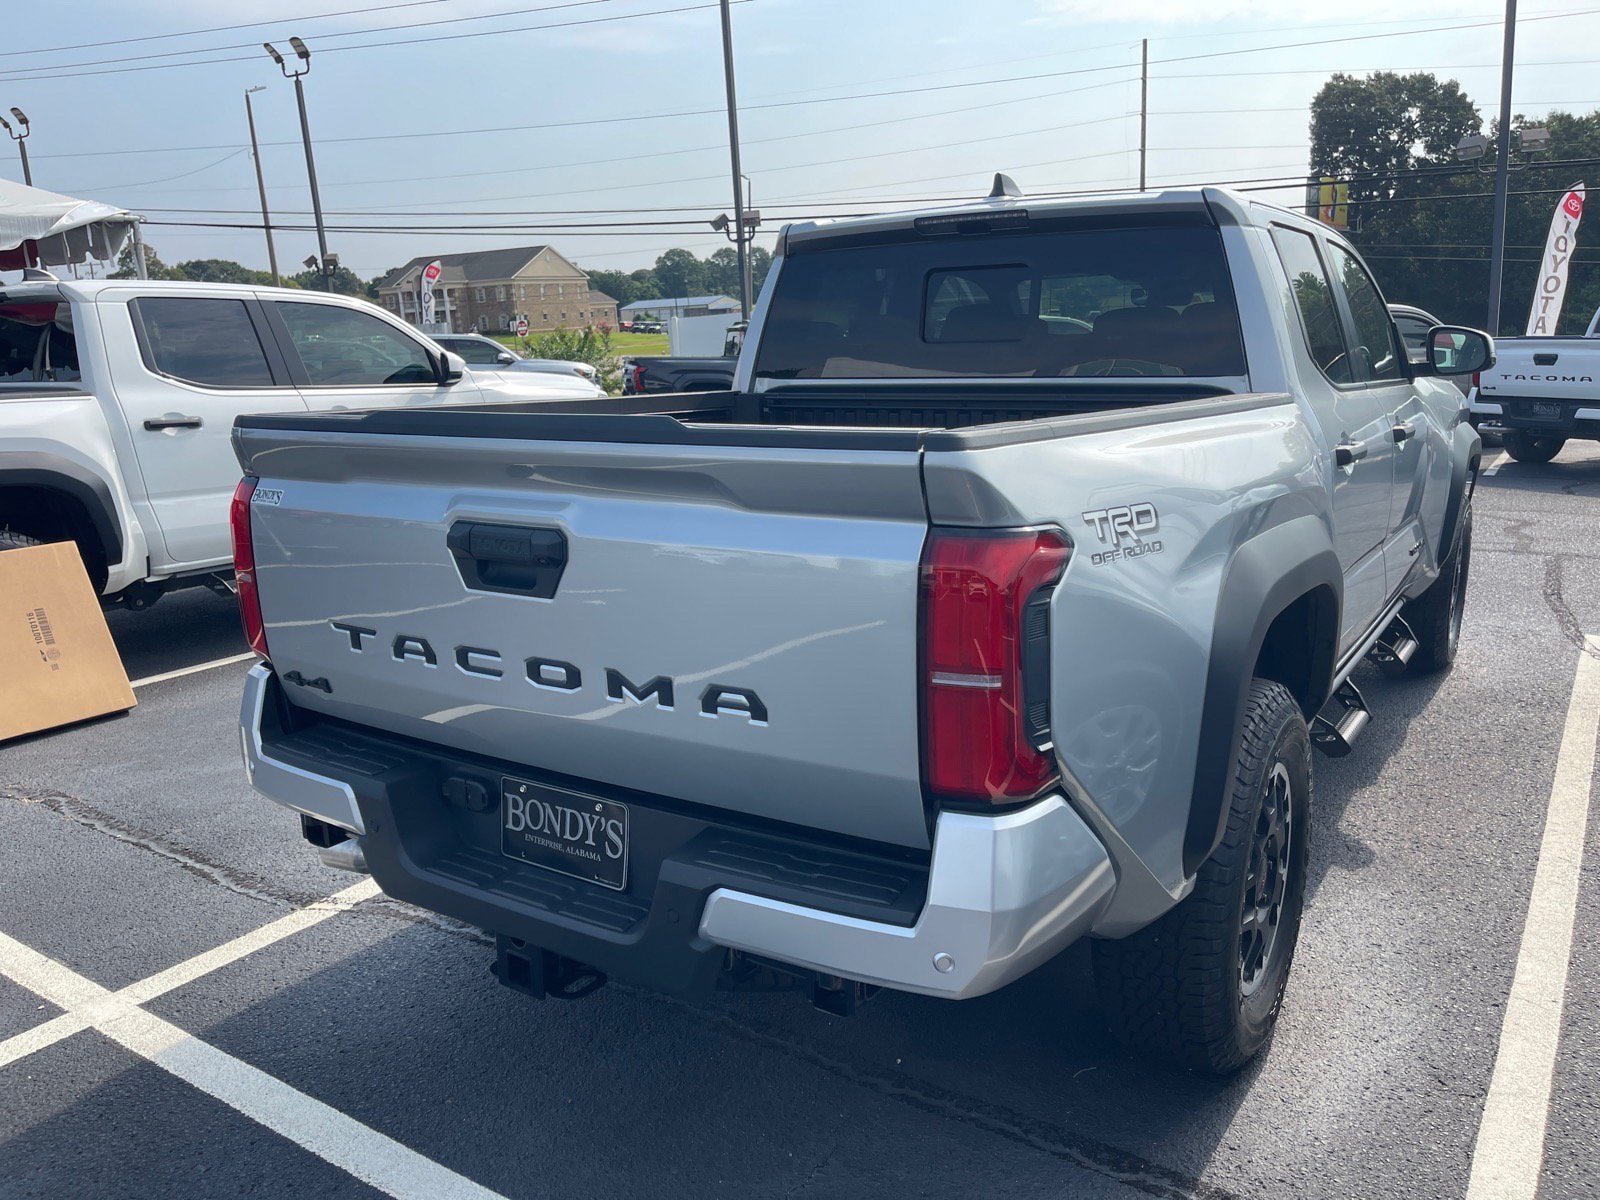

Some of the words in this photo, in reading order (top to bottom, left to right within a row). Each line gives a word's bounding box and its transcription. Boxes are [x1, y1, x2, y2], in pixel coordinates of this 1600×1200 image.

[1533, 216, 1572, 334] TOYOTA
[1500, 374, 1592, 382] TACOMA
[252, 488, 283, 505] BONDY'S
[1082, 502, 1159, 547] TRD
[1091, 549, 1121, 565] OFF
[1123, 541, 1163, 560] ROAD
[330, 620, 769, 727] TACOMA
[504, 792, 623, 859] BONDY'S
[525, 835, 564, 851] ENTERPRISE,
[566, 846, 601, 862] ALABAMA
